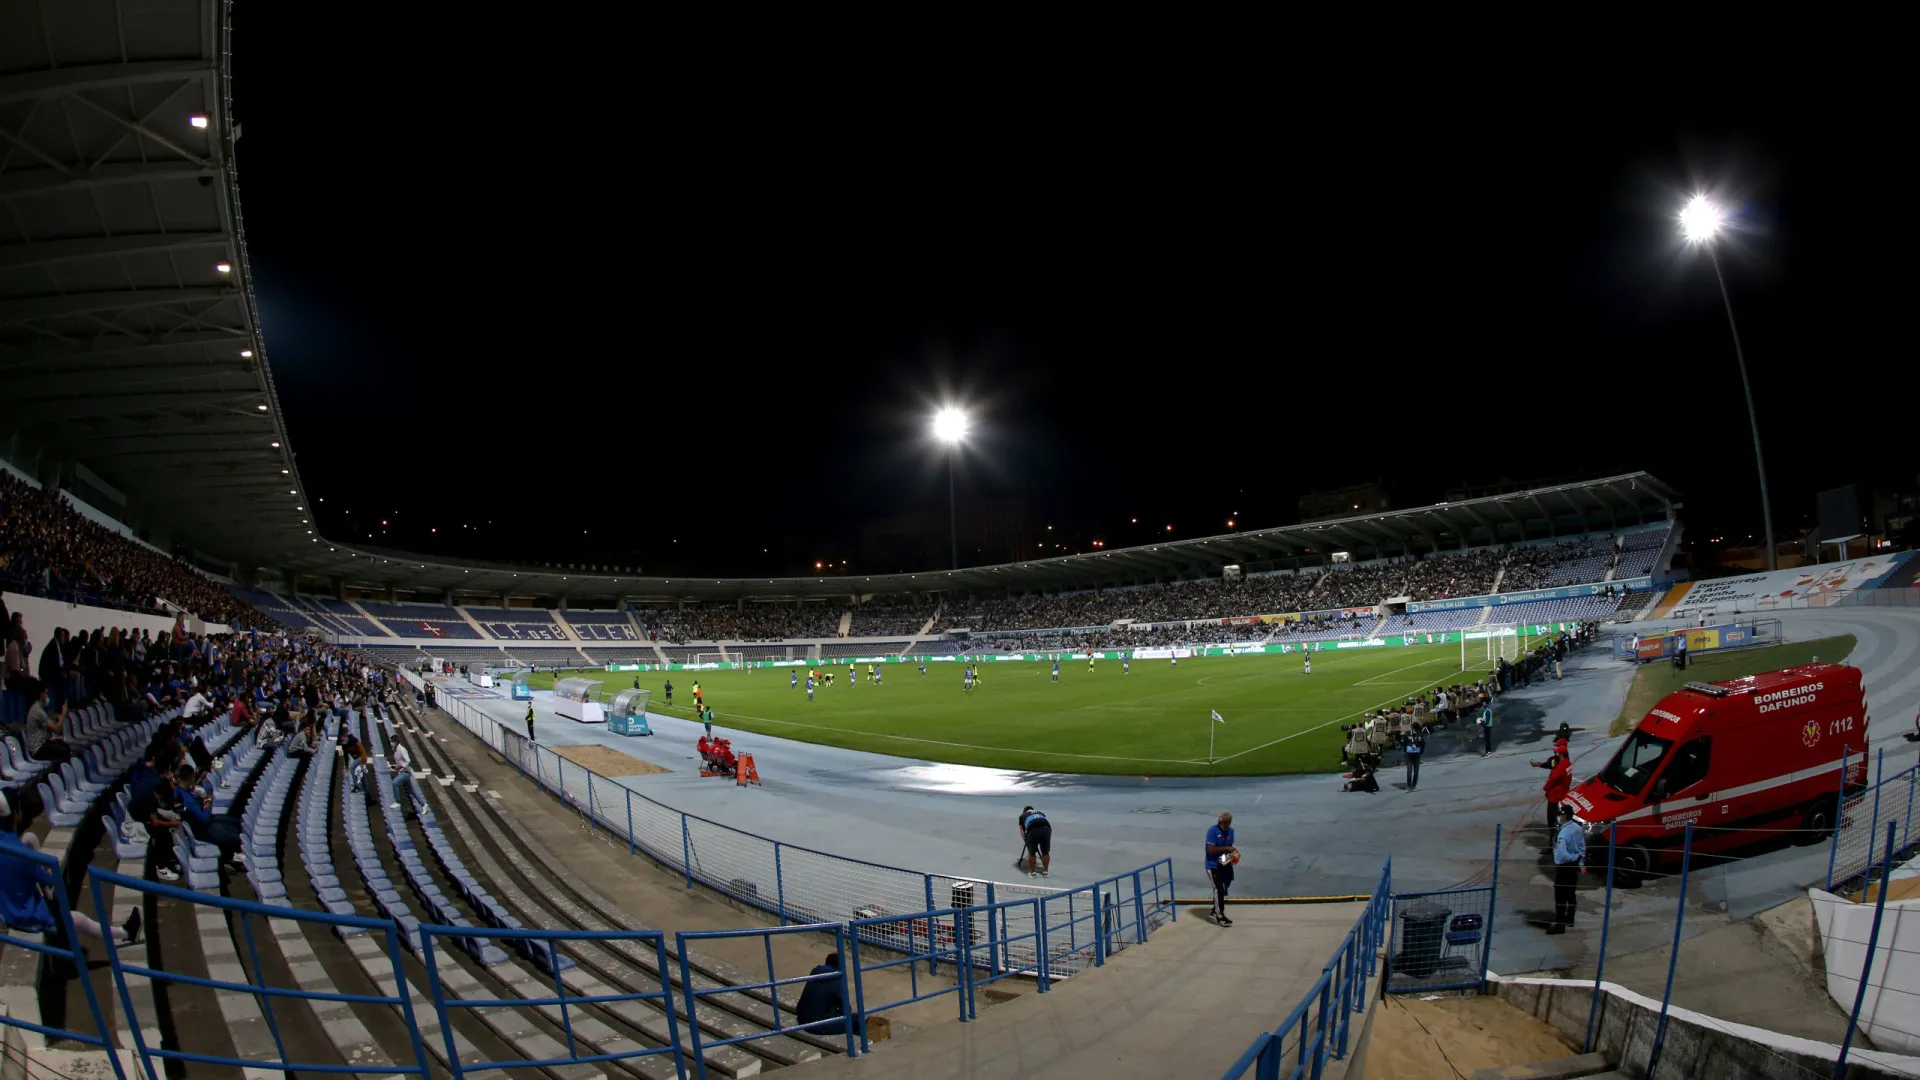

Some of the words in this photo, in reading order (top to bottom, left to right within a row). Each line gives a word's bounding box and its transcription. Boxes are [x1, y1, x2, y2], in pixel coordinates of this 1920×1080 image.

[1697, 576, 1768, 589] Descarrega
[1508, 594, 1535, 602] HOSPITAL
[1683, 597, 1707, 605] 500
[1709, 592, 1756, 603] pontos!
[1699, 590, 1736, 599] ganha
[1754, 681, 1824, 705] BOMBEIROS
[1759, 693, 1816, 714] DAFUNDO
[1662, 809, 1703, 824] BOMBEIROS
